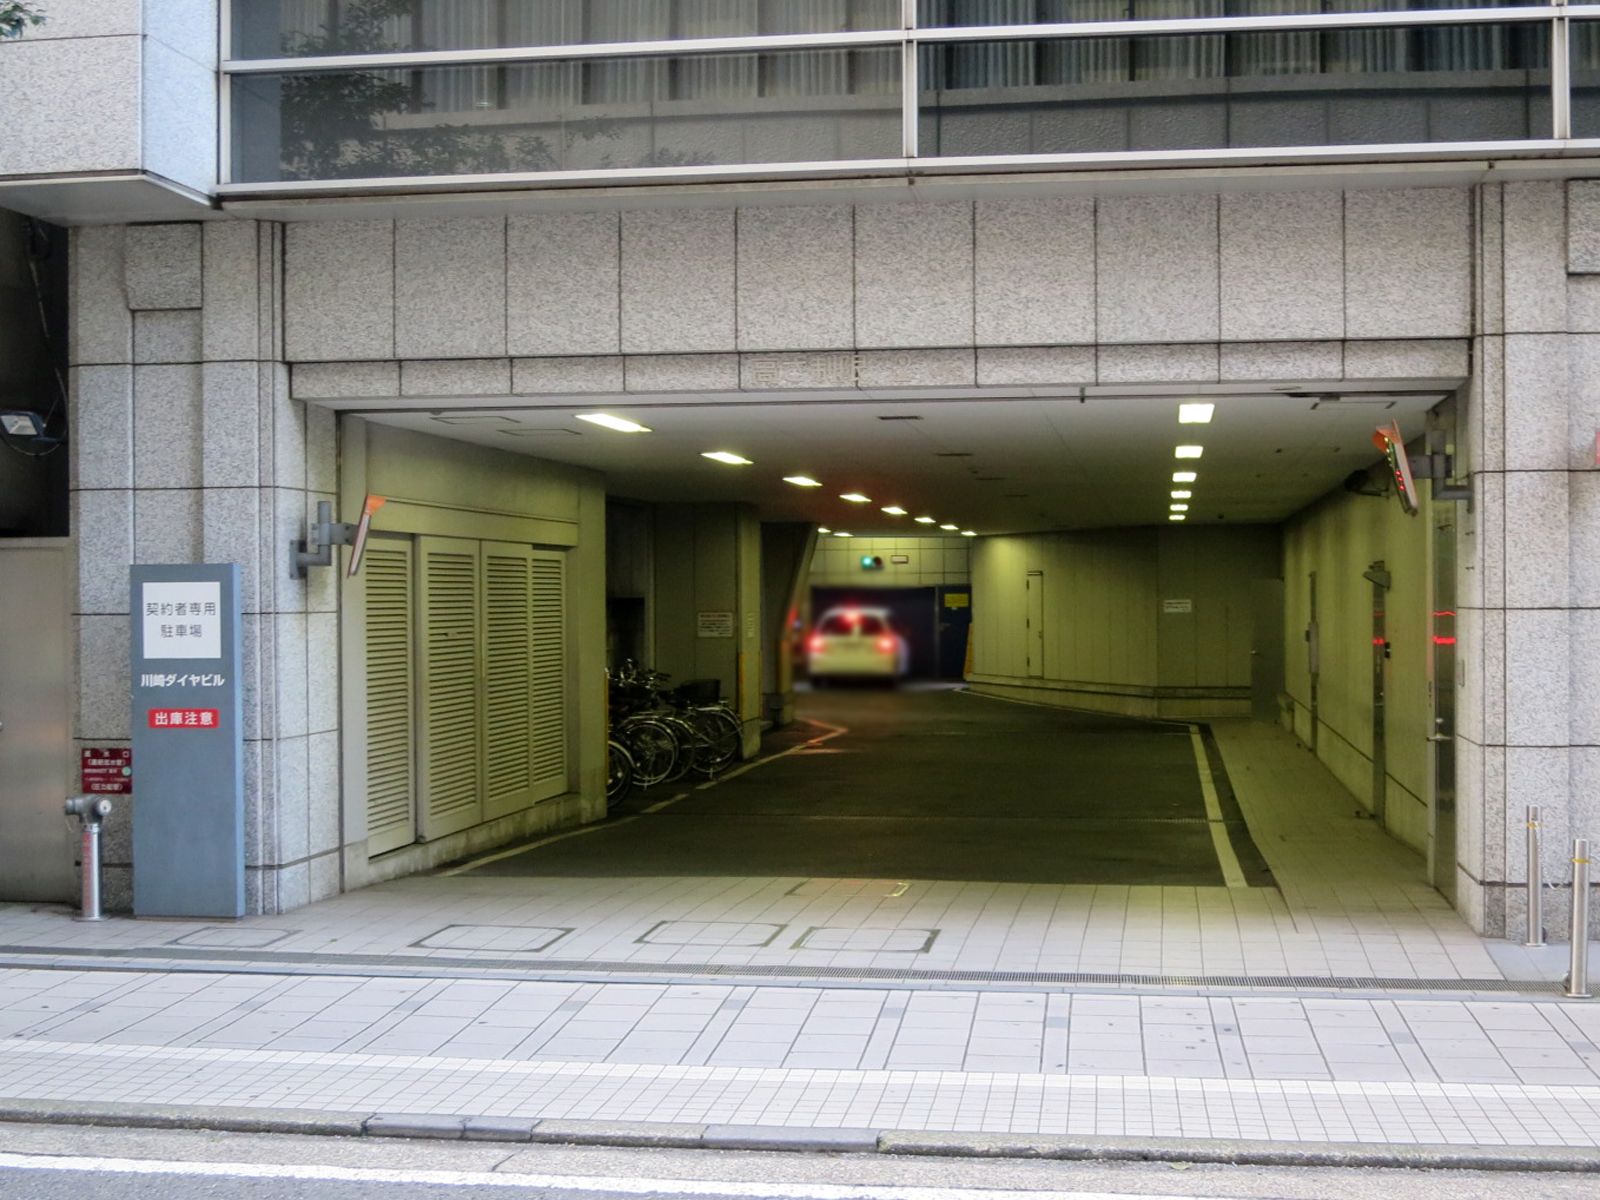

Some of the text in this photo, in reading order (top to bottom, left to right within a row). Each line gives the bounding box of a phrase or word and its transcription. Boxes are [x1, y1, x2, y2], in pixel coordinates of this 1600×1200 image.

[146, 602, 216, 616] 契約者専用
[160, 624, 202, 638] 駐車場
[141, 674, 225, 687] 川崎ダイヤビル
[155, 712, 214, 726] 出庫注意
